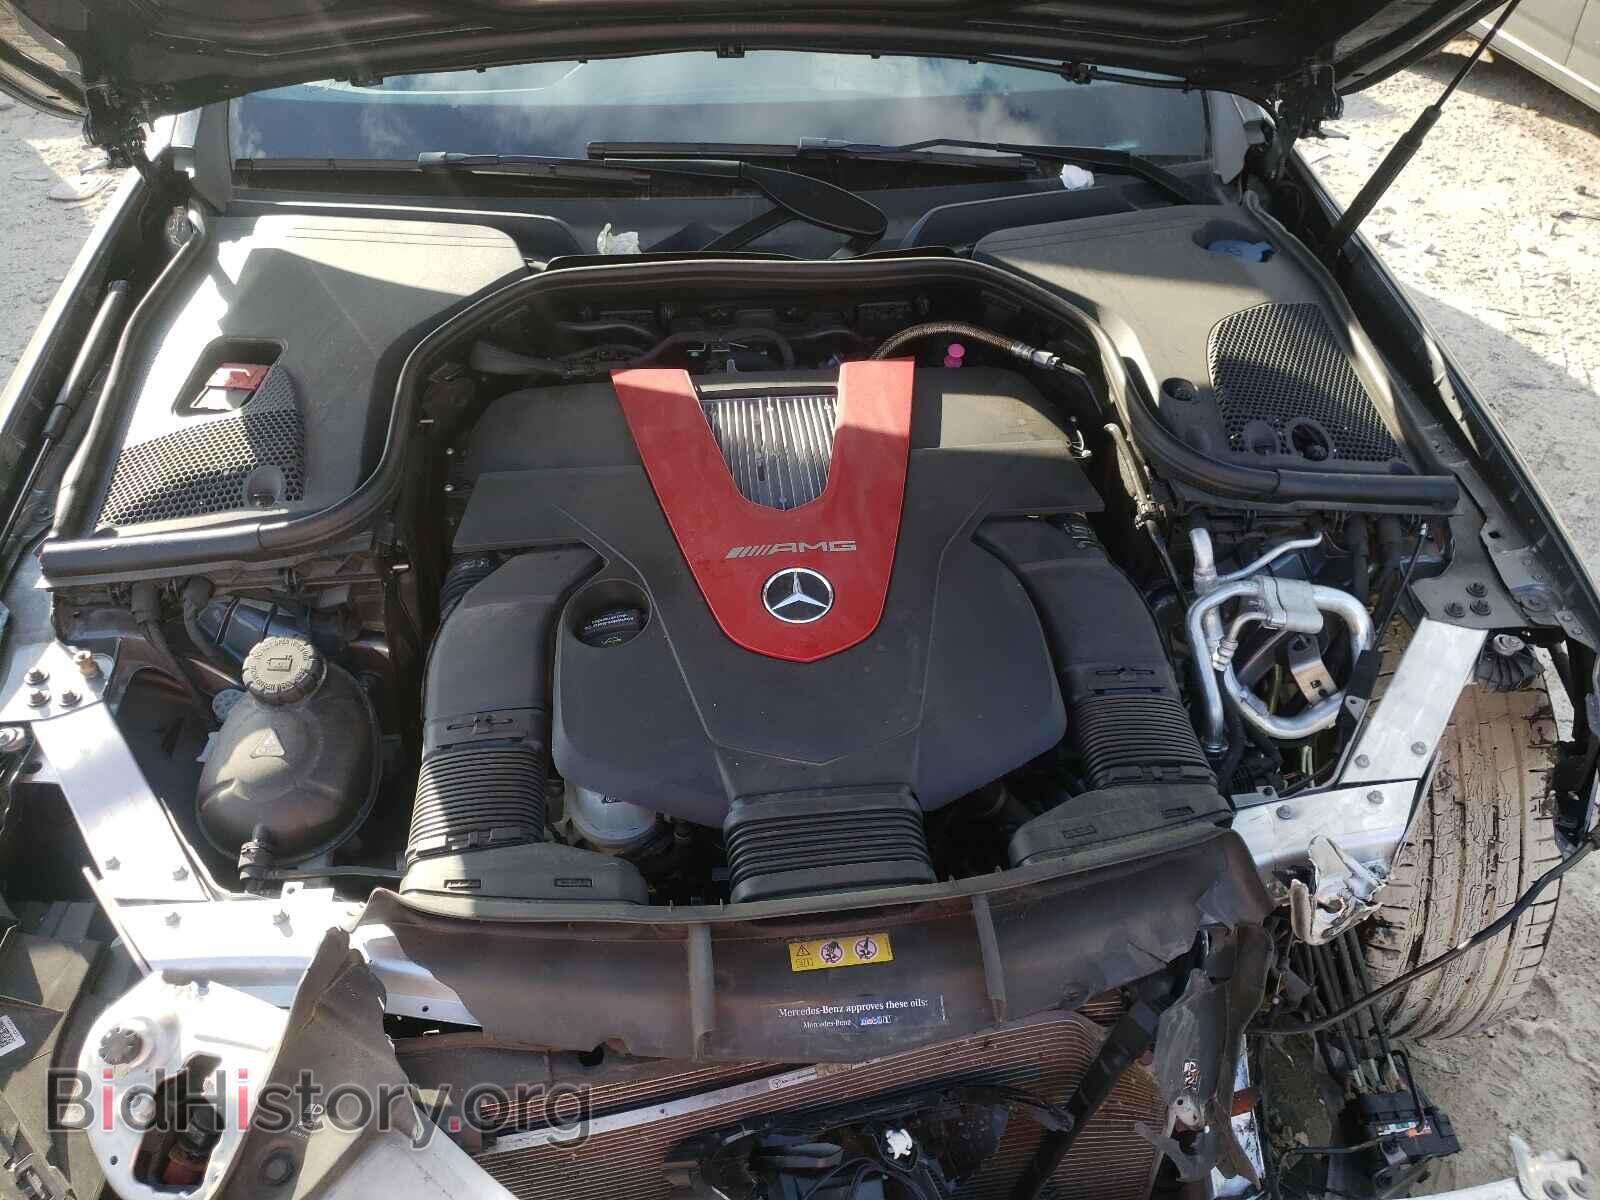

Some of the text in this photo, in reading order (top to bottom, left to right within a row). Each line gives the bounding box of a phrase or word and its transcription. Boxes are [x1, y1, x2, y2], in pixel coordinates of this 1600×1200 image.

[767, 540, 857, 556] AMG
[778, 998, 929, 1018] Mercedes-Benz approves these oils:
[803, 1019, 852, 1029] Mercedes-Benz
